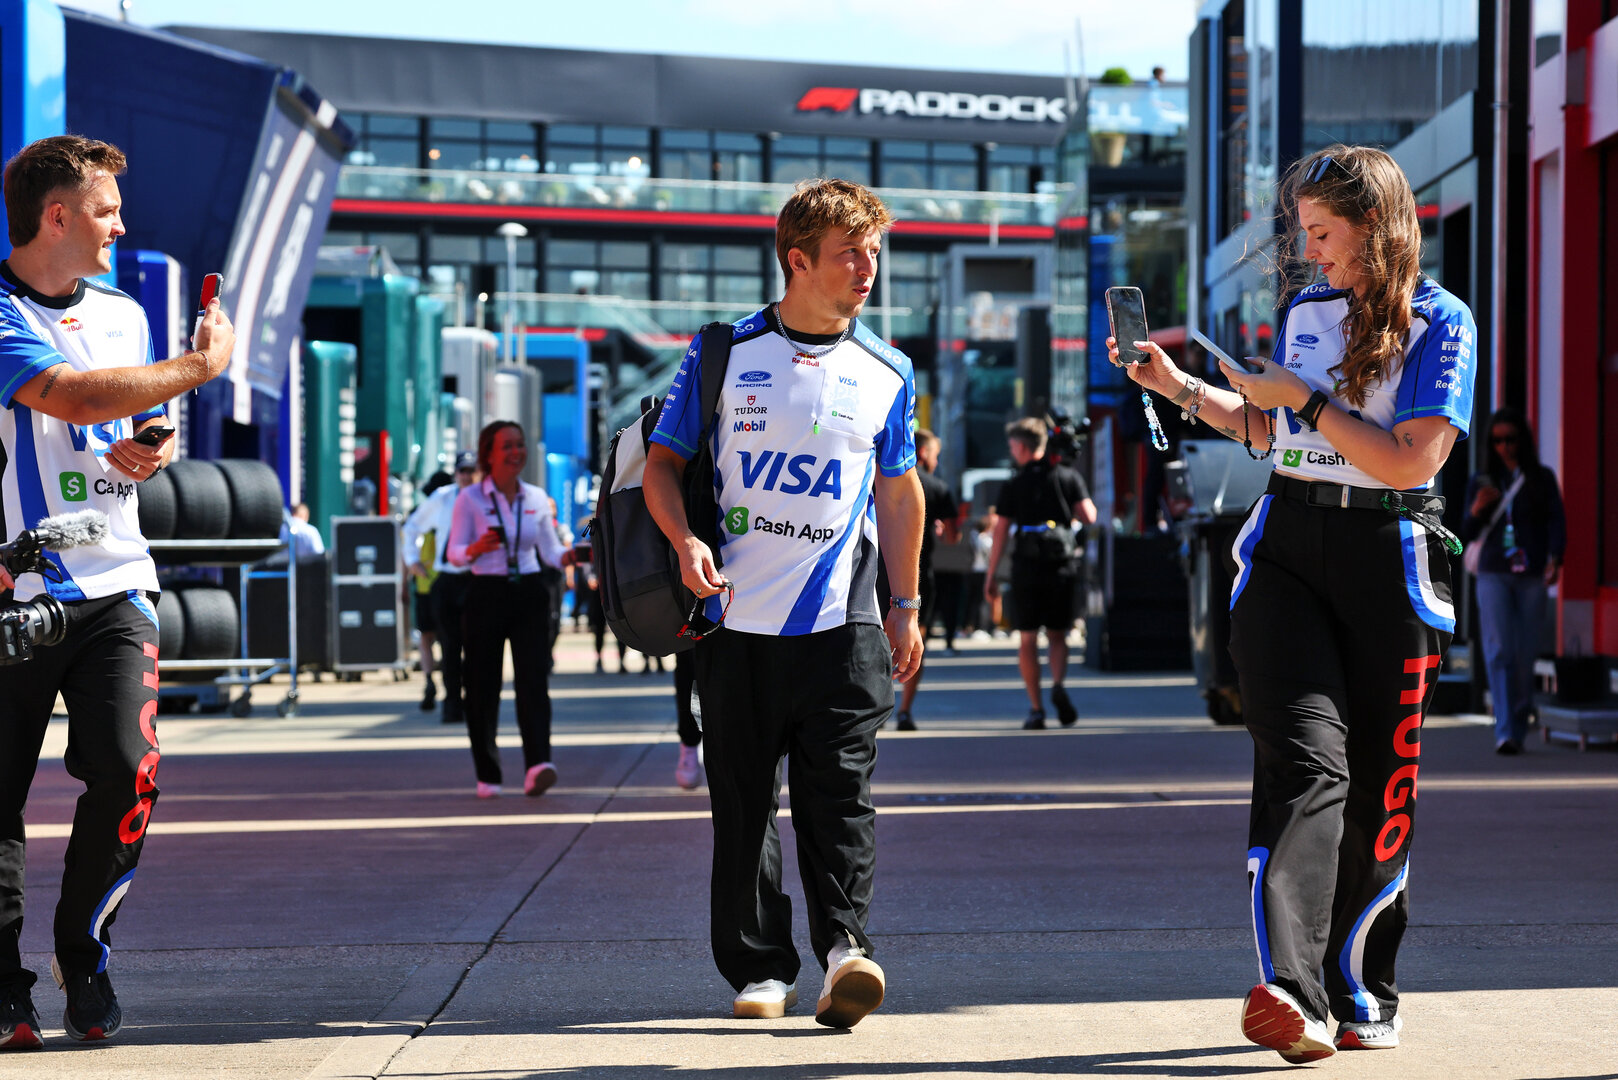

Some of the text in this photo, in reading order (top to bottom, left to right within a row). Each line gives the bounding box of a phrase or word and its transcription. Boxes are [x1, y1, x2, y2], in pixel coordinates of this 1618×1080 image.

[858, 87, 1067, 123] PADDOCK
[106, 330, 124, 338] VISA
[865, 337, 903, 365] HUGO
[792, 357, 820, 367] Red Bull
[838, 376, 858, 387] VISA
[1435, 379, 1455, 390] Red
[734, 406, 768, 416] TUDOR
[733, 420, 767, 433] Mobil
[1306, 451, 1346, 466] Cash
[736, 450, 842, 500] VISA
[117, 482, 134, 498] App
[753, 516, 796, 539] Cash
[797, 523, 834, 543] App
[1374, 654, 1441, 862] HUGO
